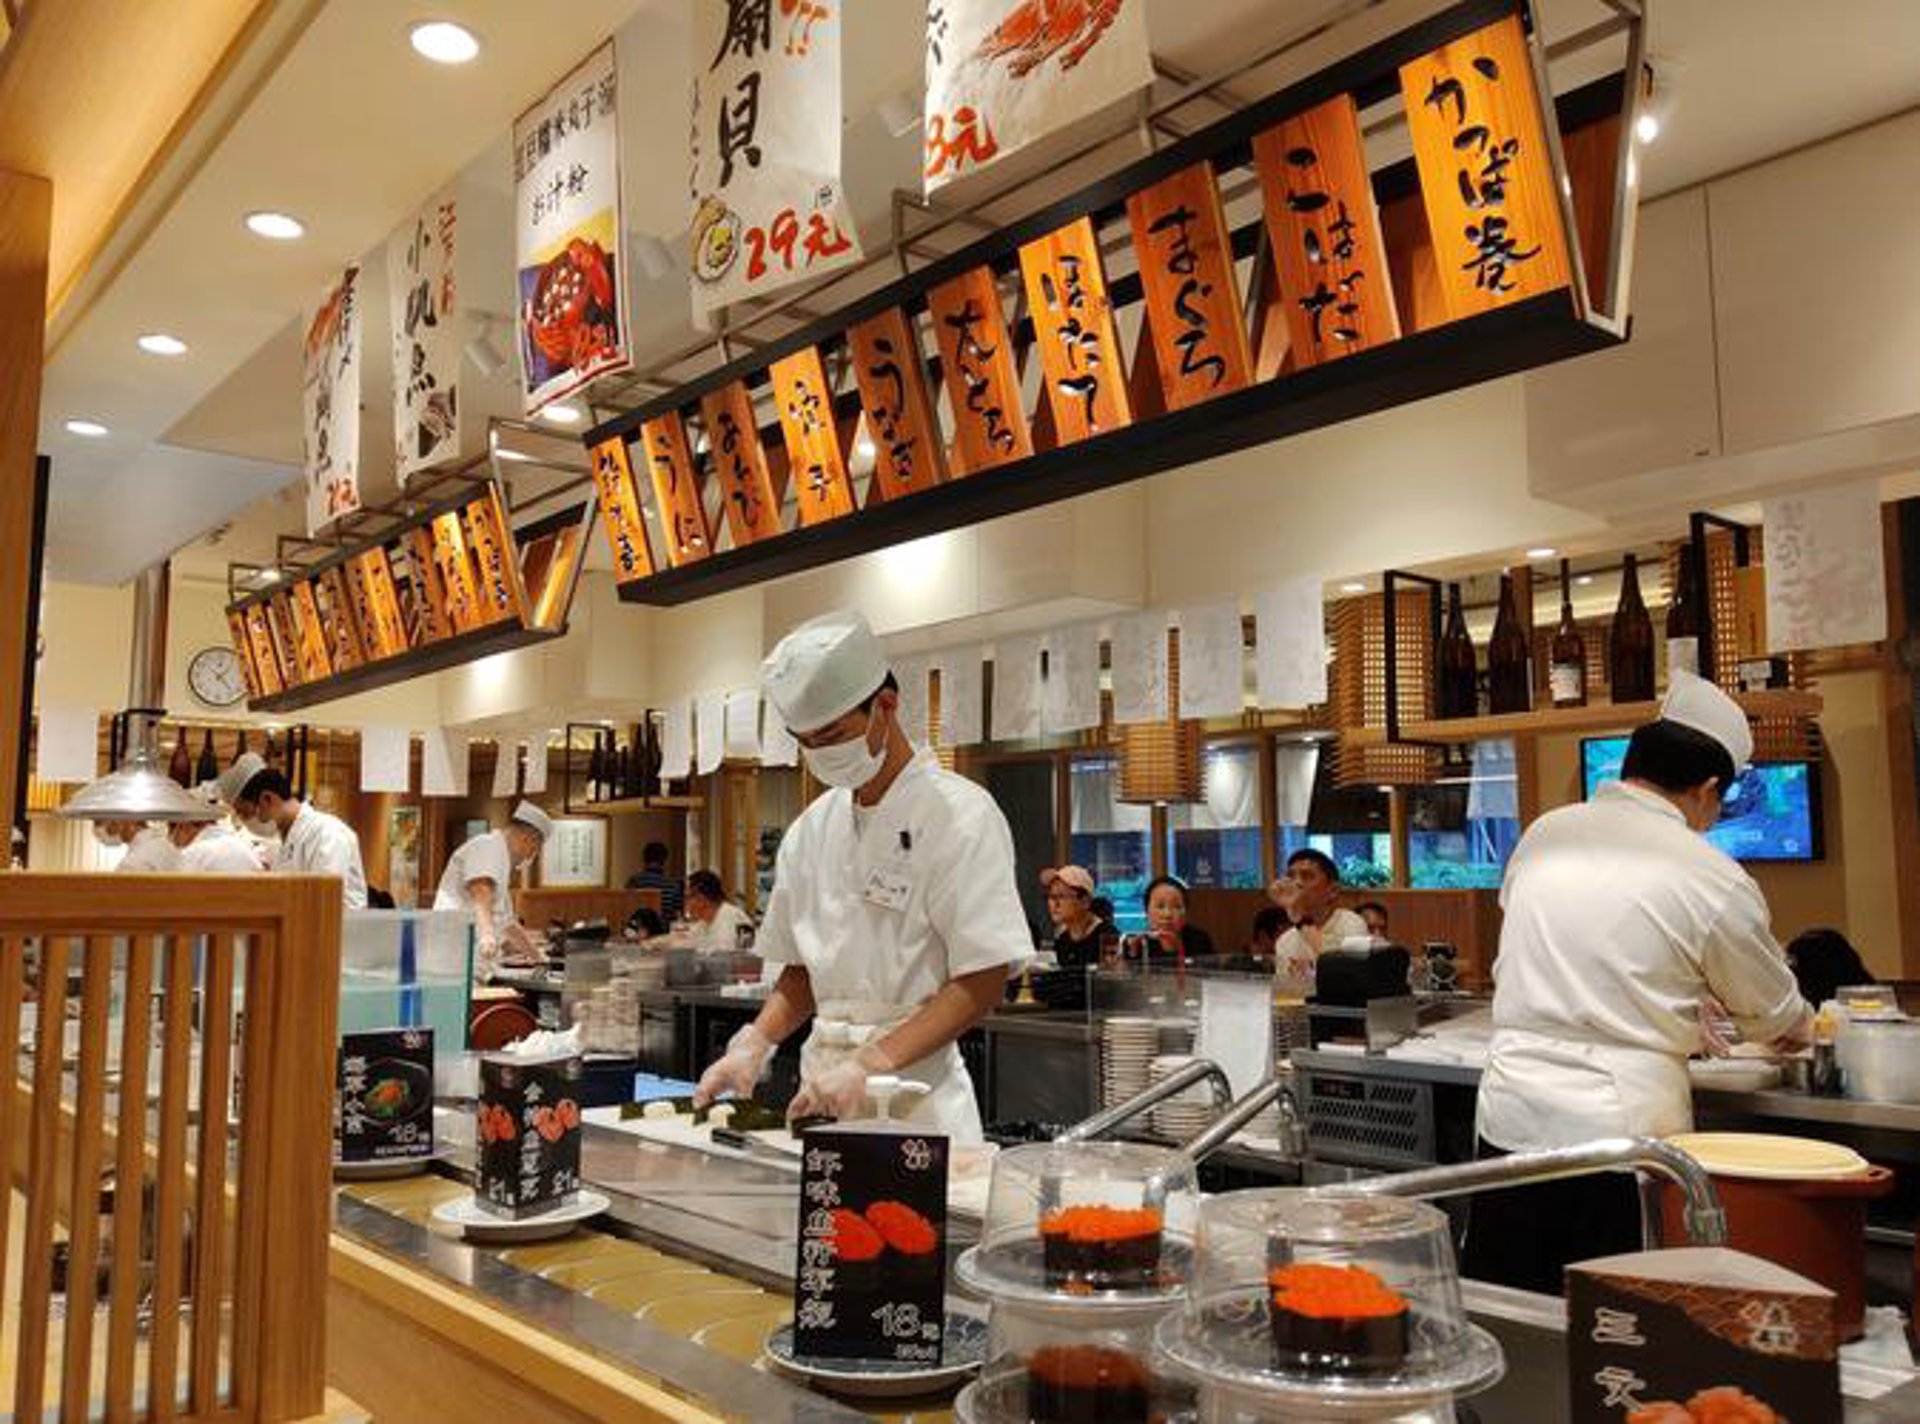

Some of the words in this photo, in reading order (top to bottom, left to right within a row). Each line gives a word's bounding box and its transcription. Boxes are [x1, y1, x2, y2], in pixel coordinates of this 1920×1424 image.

[743, 208, 851, 282] 29元
[1148, 205, 1226, 388] まぐろ
[869, 338, 915, 477] うなぎ
[1041, 255, 1099, 430] ほたて
[654, 435, 704, 553] うに
[788, 380, 831, 502] 穴子
